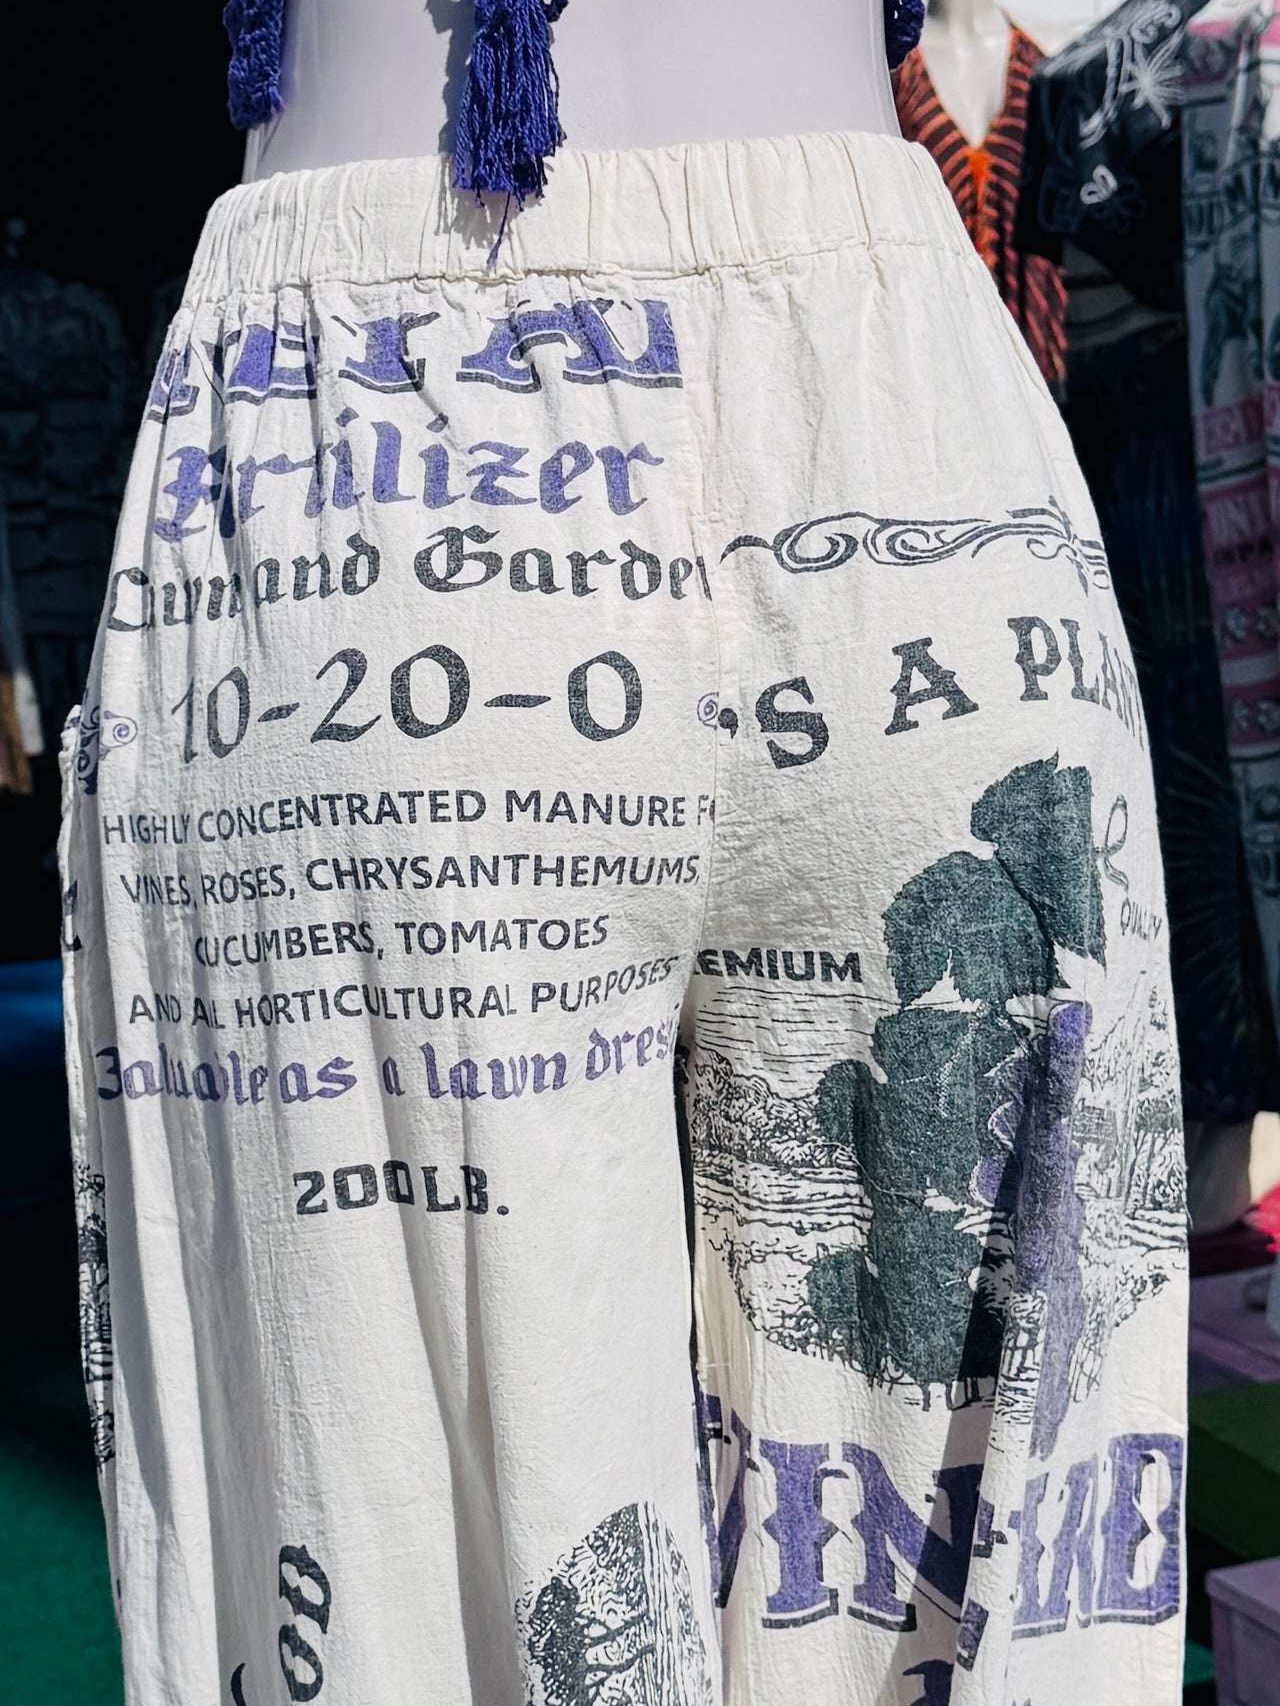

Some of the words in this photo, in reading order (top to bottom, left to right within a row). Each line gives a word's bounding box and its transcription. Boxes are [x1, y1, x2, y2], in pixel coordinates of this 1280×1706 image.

[883, 637, 980, 735] A
[103, 813, 190, 844] HIGHLY
[197, 789, 487, 843] CONCENTRATED
[505, 789, 687, 827] MANURE
[200, 864, 296, 905] ROSES,
[305, 854, 701, 892] CHRYSANTHEMUMS,
[194, 919, 385, 967] CUCUMBERS,
[394, 914, 611, 956] TOMATOES
[129, 993, 182, 1024] AND
[234, 984, 518, 1029] HORTICULTURAL
[530, 955, 680, 1014] PURPOSES
[292, 1159, 510, 1217] 200LB.
